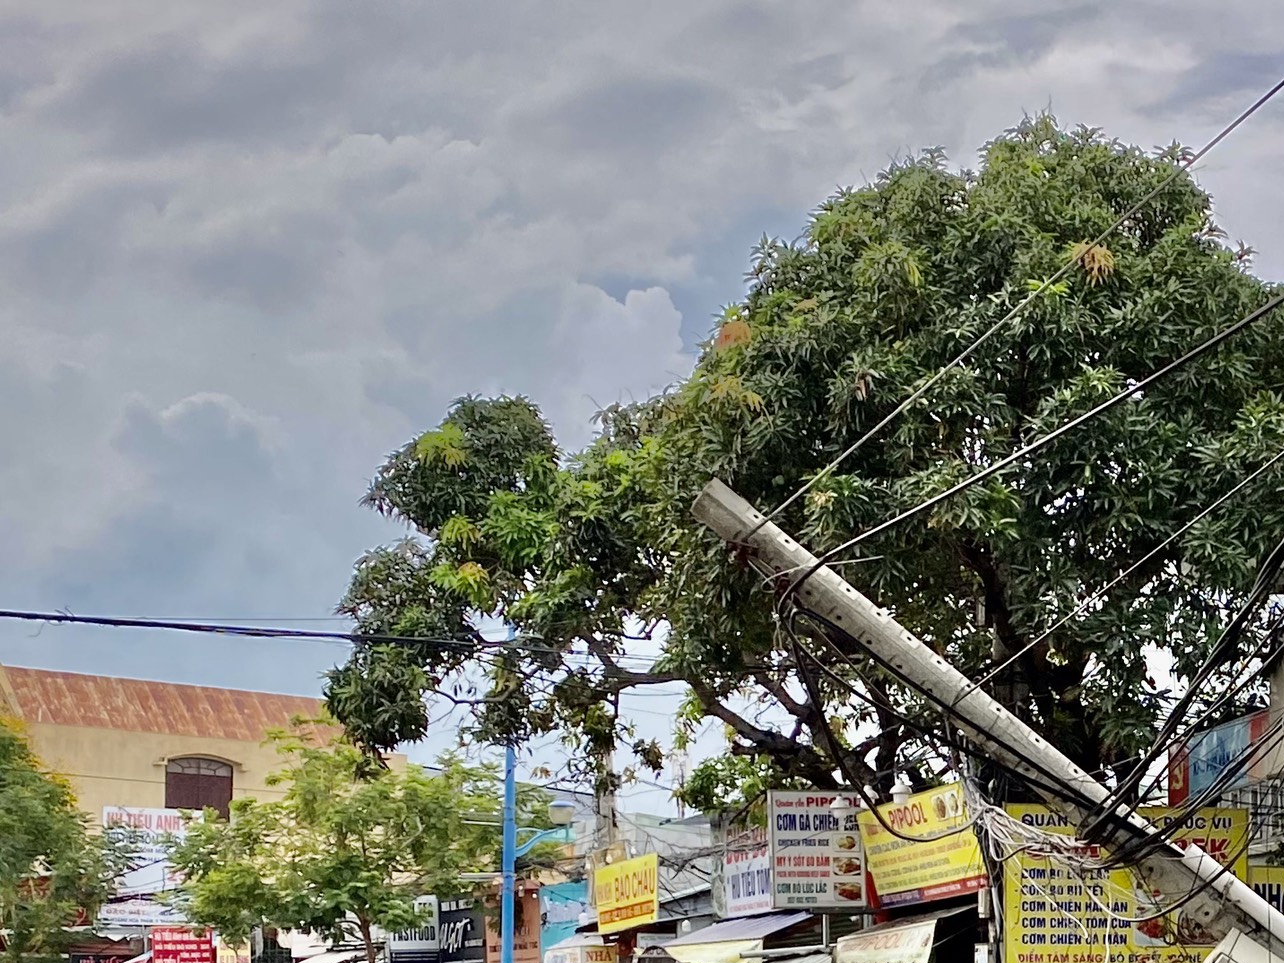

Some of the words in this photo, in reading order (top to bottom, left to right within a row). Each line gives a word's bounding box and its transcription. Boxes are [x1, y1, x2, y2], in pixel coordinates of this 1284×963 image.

[776, 812, 797, 831] CƠM
[887, 801, 928, 829] PIPOOL
[1021, 900, 1046, 912] CƠM
[1021, 917, 1046, 929] CƠM
[1021, 934, 1046, 945] CƠM
[1050, 931, 1082, 945] CHIÊN
